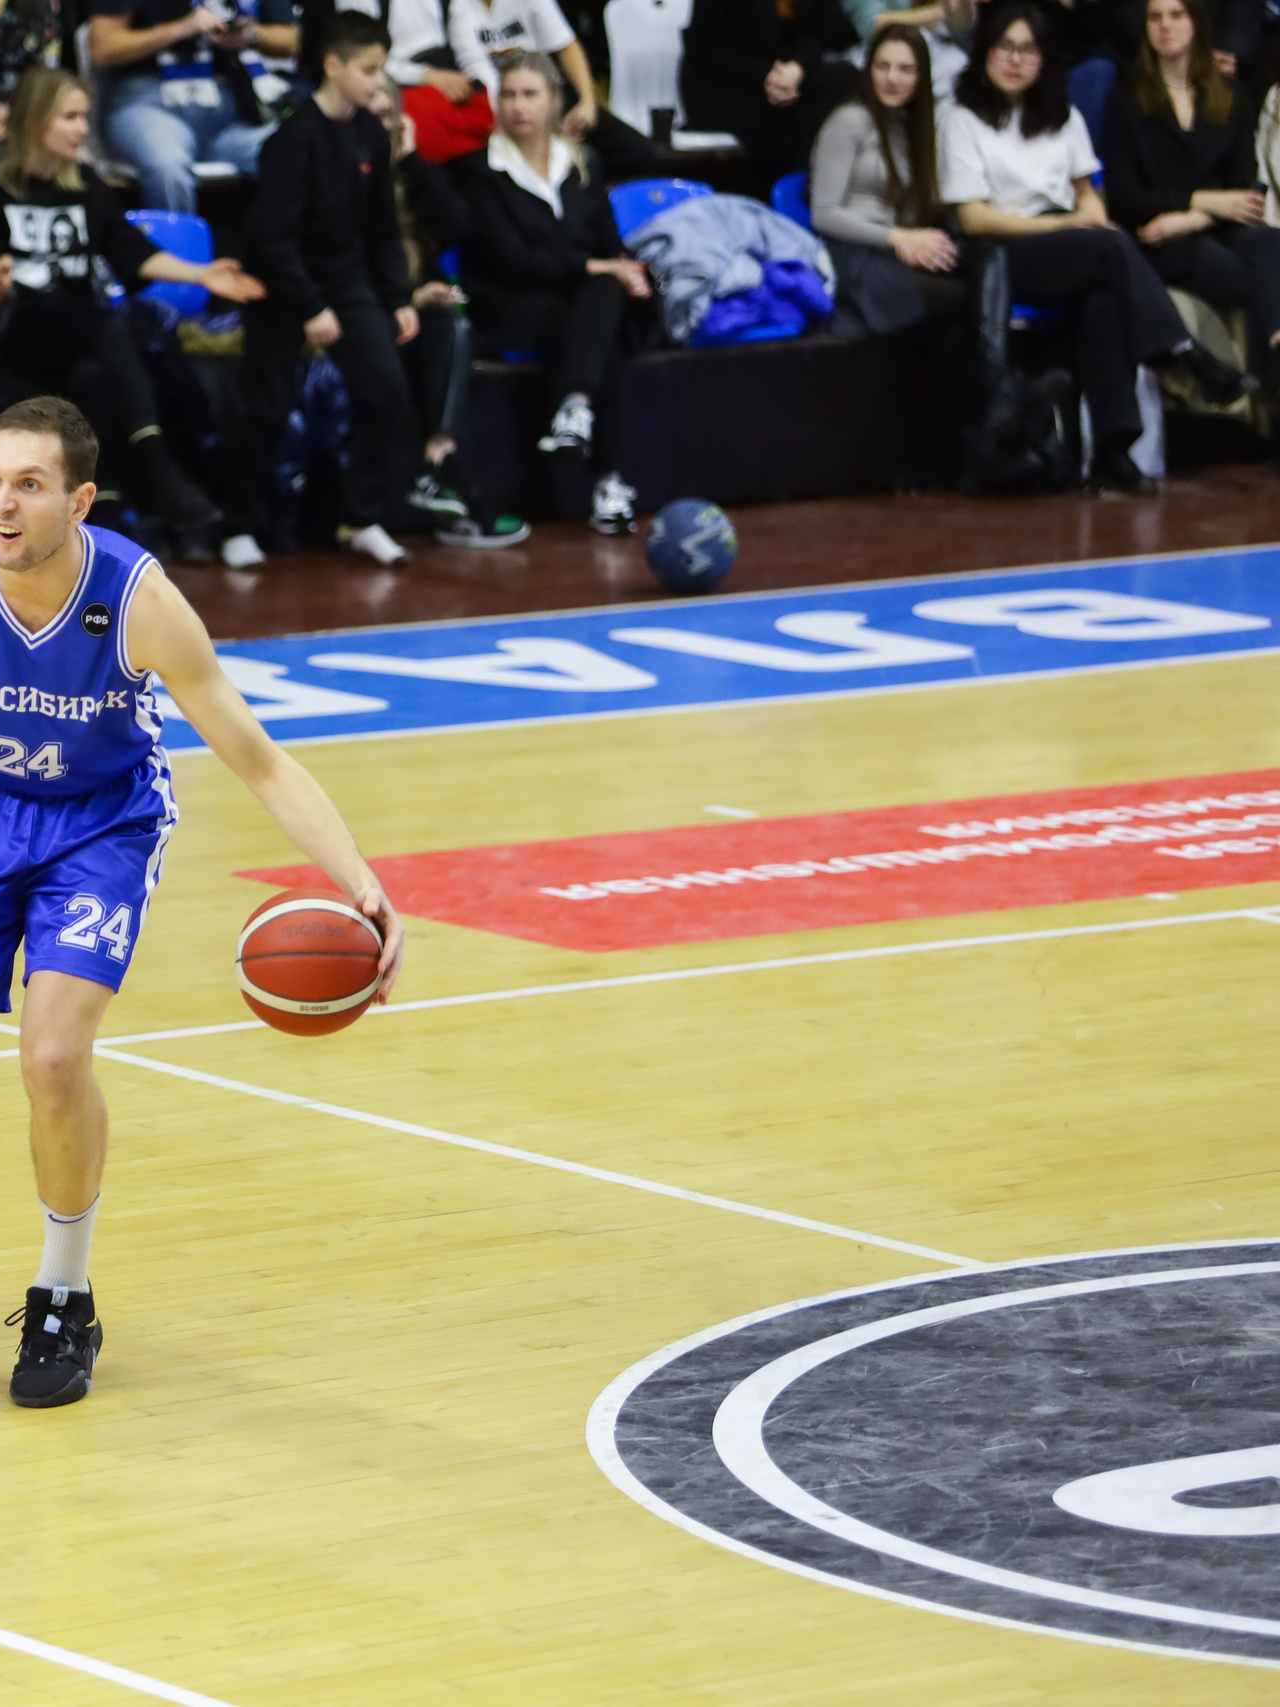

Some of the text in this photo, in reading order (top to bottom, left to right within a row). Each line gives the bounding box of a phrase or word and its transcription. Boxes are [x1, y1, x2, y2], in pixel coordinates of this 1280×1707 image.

[85, 614, 109, 625] РФБ
[917, 790, 1280, 839] омпания
[56, 893, 133, 964] 24
[280, 921, 347, 939] molten
